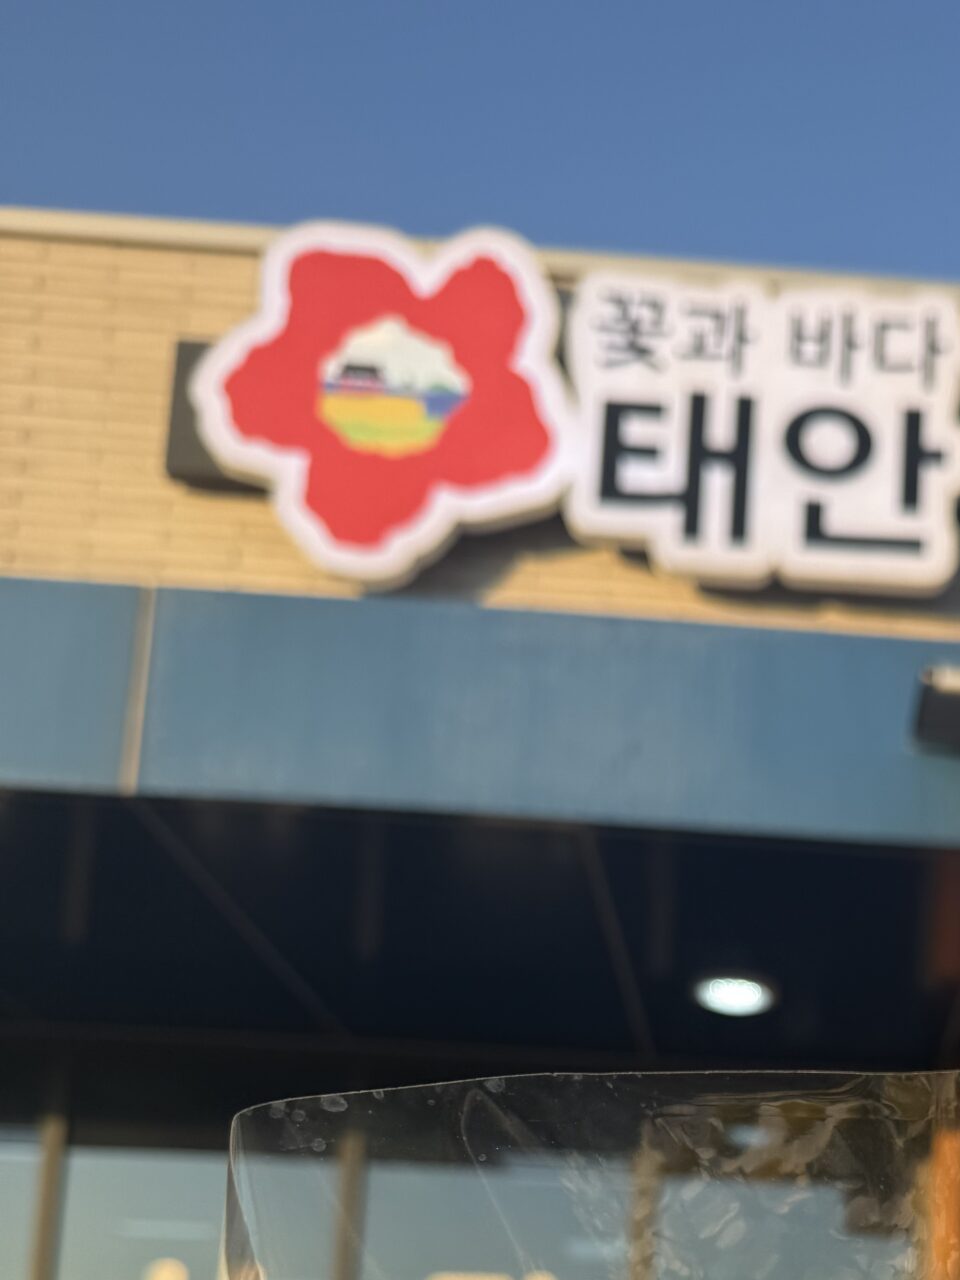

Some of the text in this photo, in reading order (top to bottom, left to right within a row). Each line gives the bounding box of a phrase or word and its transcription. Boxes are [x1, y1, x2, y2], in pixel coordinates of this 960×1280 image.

[595, 288, 948, 391] 꽃과 바다
[598, 392, 948, 554] 태안
